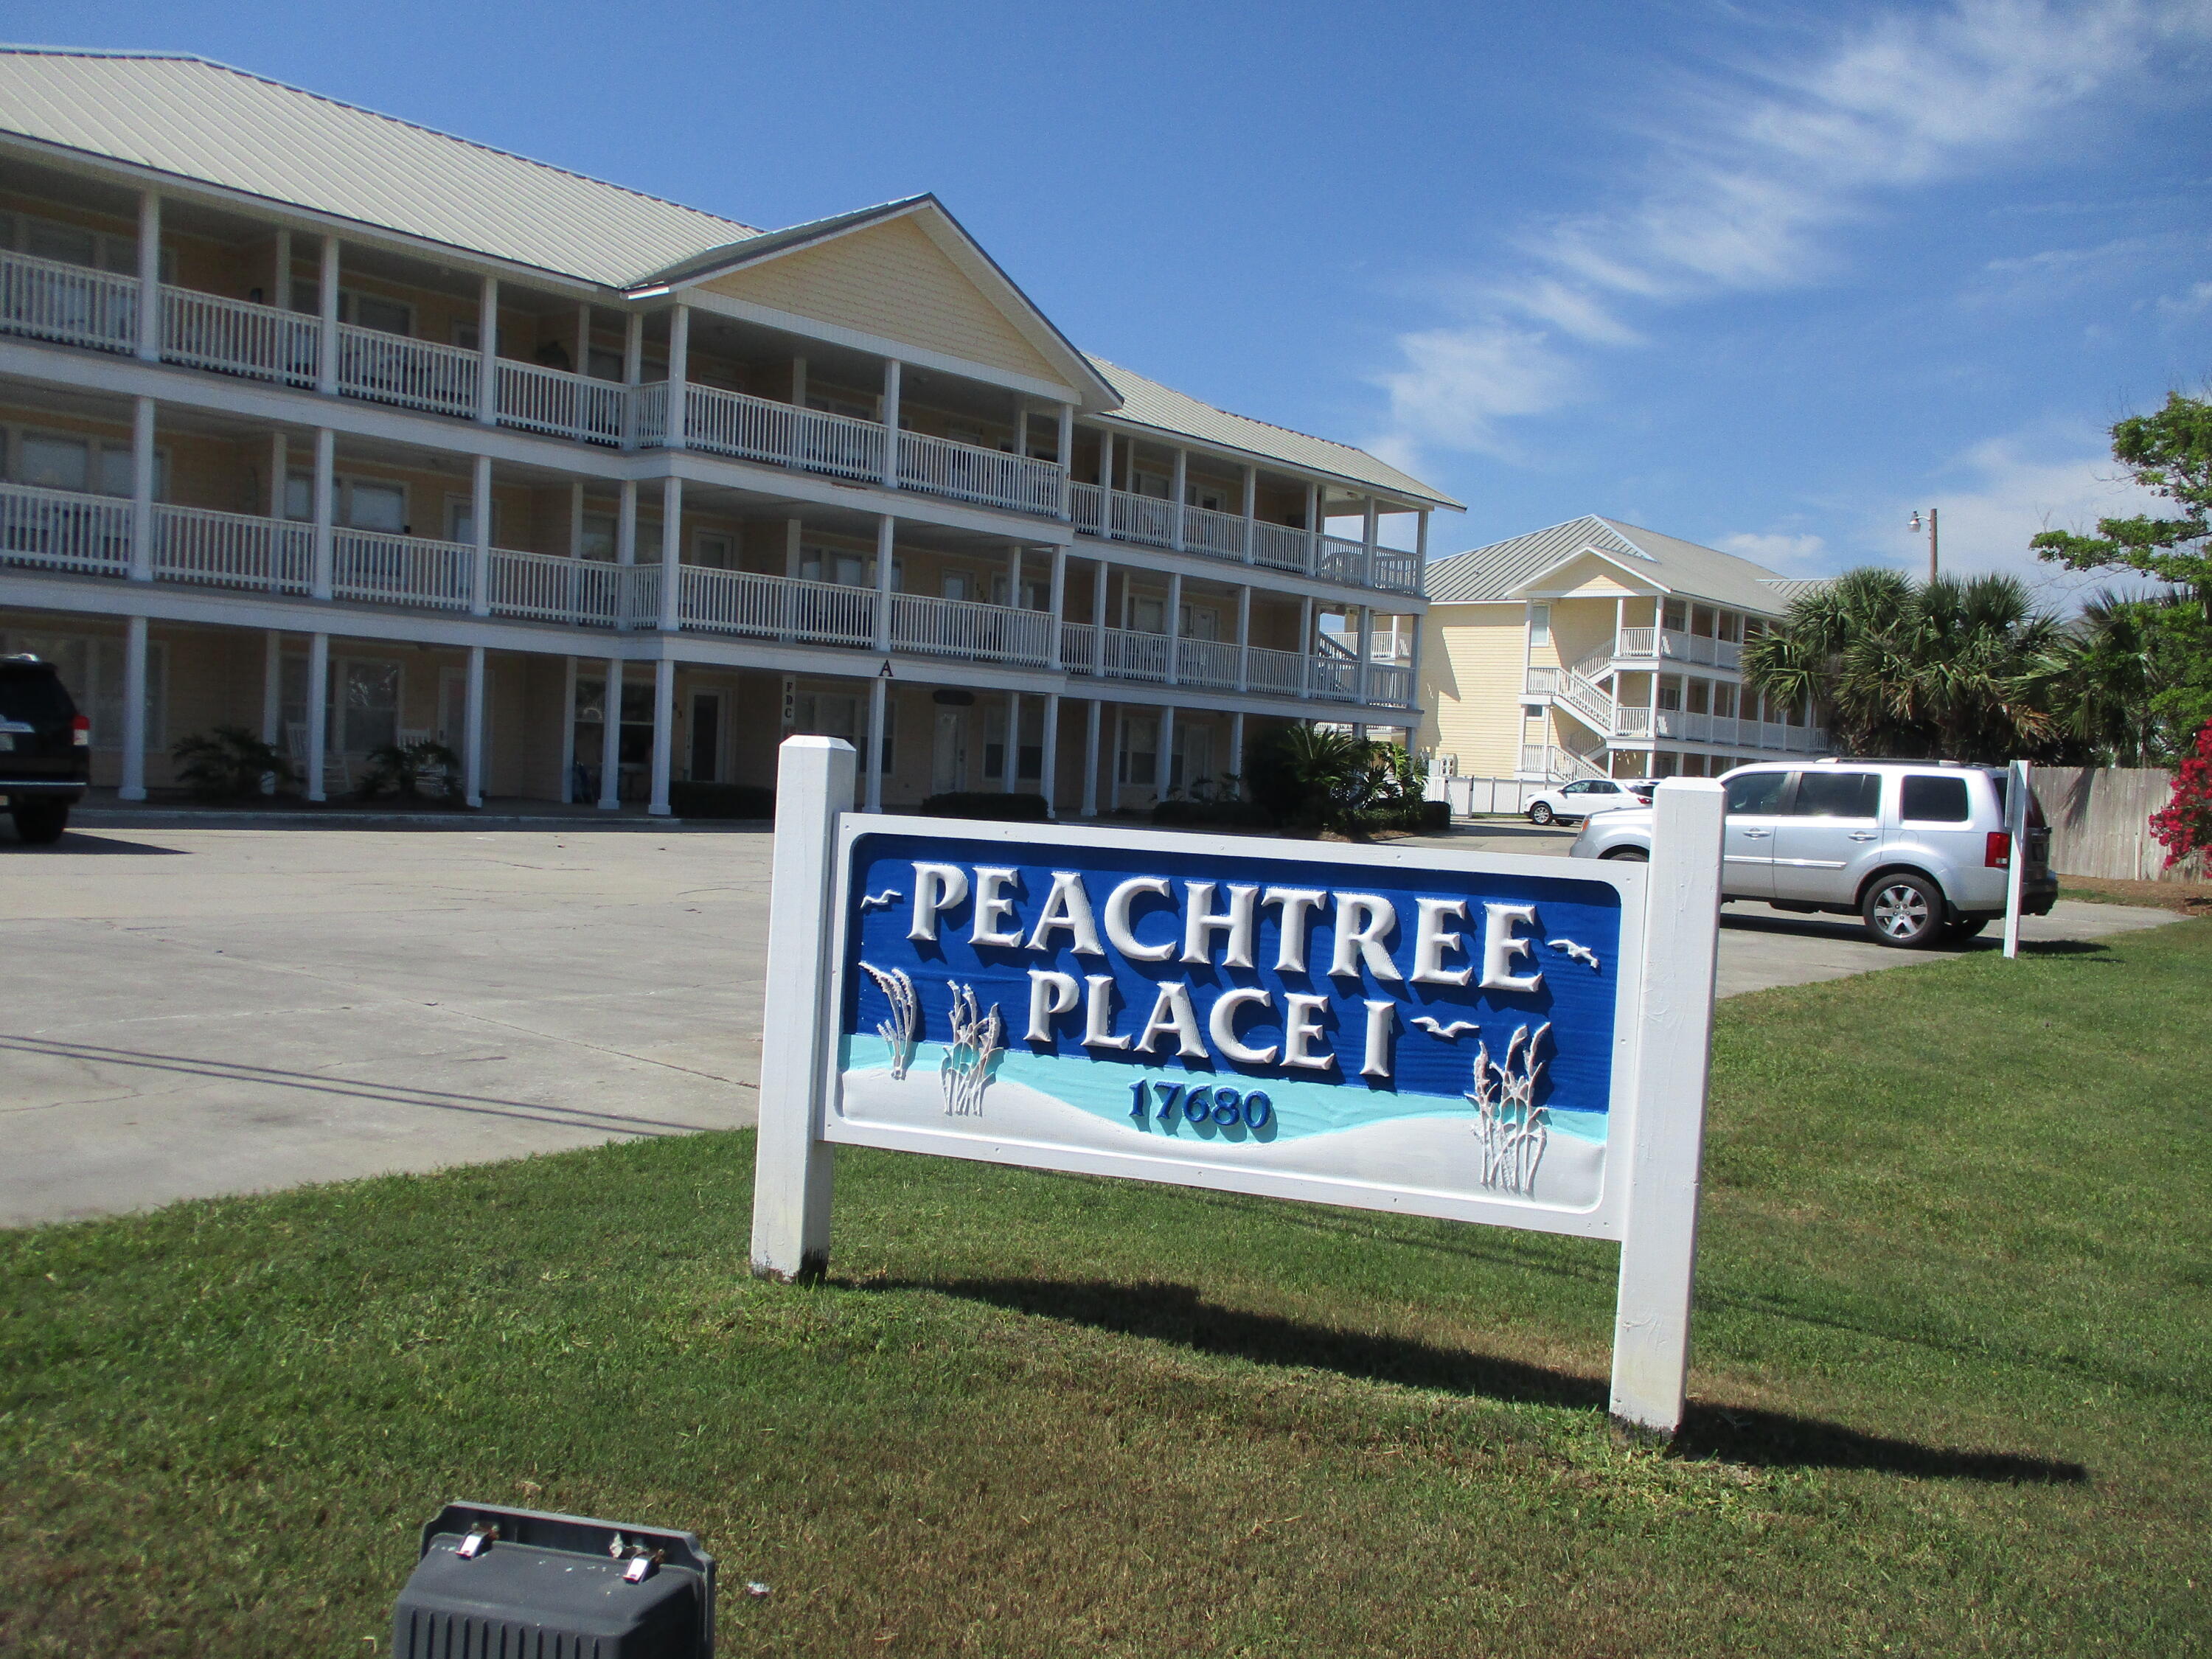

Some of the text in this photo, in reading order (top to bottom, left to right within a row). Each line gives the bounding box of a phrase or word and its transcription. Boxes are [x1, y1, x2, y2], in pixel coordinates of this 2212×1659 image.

[879, 658, 894, 678] A
[906, 860, 1544, 993] PEACHTREE
[1023, 969, 1397, 1078] PLACE I
[1129, 1079, 1273, 1132] 17680
